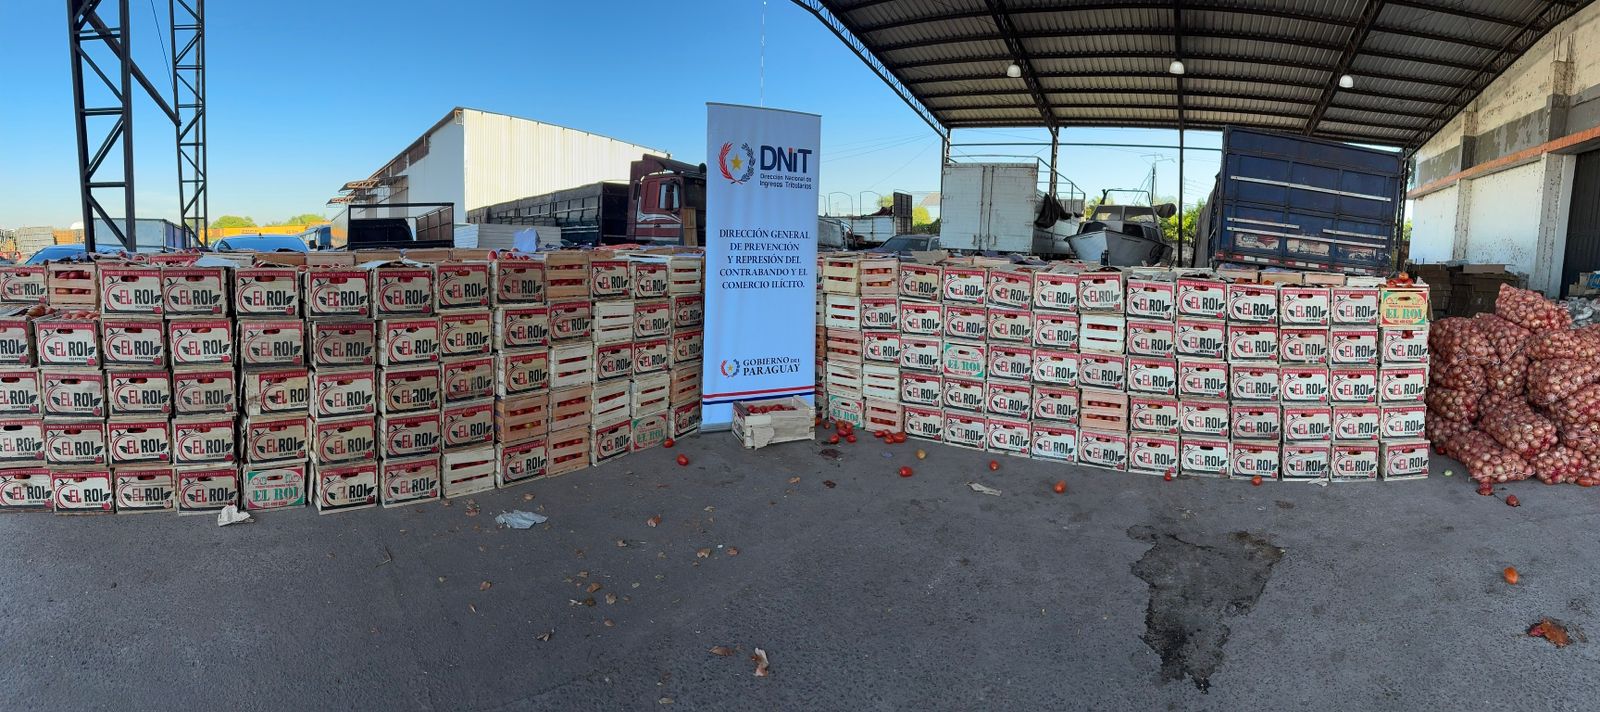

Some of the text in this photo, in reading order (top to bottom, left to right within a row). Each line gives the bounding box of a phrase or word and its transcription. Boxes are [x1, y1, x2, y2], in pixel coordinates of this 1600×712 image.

[719, 228, 810, 239] DIRECCIÓN GENERAL
[730, 241, 799, 251] DE PREVENCIÓN
[727, 254, 801, 264] Y REPRESIÓN DEL
[13, 282, 40, 295] EL ROI
[453, 281, 482, 297] EL ROI
[722, 279, 805, 289] COMERCIO ILÍCITO.
[910, 280, 932, 292] EL ROI
[120, 289, 155, 305] EL ROI
[180, 289, 212, 305] EL ROI
[254, 289, 285, 305] EL ROI
[394, 288, 424, 305] EL ROI
[1056, 290, 1070, 303] ROI
[1090, 290, 1114, 302] EL ROI
[1190, 296, 1218, 309] EL ROI
[1140, 298, 1164, 311] EL ROI
[1243, 302, 1269, 316] EL ROI
[1345, 304, 1369, 317] EL ROI
[912, 318, 934, 328] EL ROI
[1000, 324, 1024, 335] EL ROI
[517, 325, 542, 339] EL ROI
[1048, 329, 1072, 341] EL ROI
[455, 332, 482, 346] EL ROI
[1141, 338, 1166, 351] EL ROI
[55, 341, 88, 356] EL ROI
[120, 340, 154, 356] EL ROI
[189, 340, 222, 355] EL ROI
[261, 342, 293, 356] EL ROI
[333, 341, 364, 356] EL ROI
[402, 340, 432, 355] EL ROI
[1244, 340, 1270, 353] EL ROI
[1345, 345, 1369, 357] EL ROI
[644, 354, 663, 365] EL ROI
[743, 356, 789, 365] GOBIERNO
[743, 364, 800, 376] PARAGUAY
[1001, 361, 1024, 372] EL ROI
[1055, 365, 1069, 378] ROI
[517, 368, 542, 383] EL ROI
[1142, 375, 1167, 388] EL ROI
[1192, 377, 1219, 390] EL ROI
[1294, 383, 1320, 396] EL ROI
[1393, 383, 1418, 395] EL ROI
[61, 392, 93, 406] EL ROI
[129, 390, 161, 405] EL ROI
[193, 390, 224, 405] EL ROI
[335, 392, 363, 406] EL ROI
[999, 398, 1022, 410] EL ROI
[1046, 402, 1070, 414] EL ROI
[1196, 416, 1220, 428] EL ROI
[1348, 422, 1372, 435] EL ROI
[459, 422, 486, 437] EL ROI
[1299, 423, 1324, 435] EL ROI
[4, 437, 34, 451] EL ROI
[128, 439, 159, 454] EL ROI
[193, 439, 225, 454] EL ROI
[266, 437, 296, 452] EL ROI
[402, 433, 432, 449] EL ROI
[999, 434, 1022, 446] EL ROI
[61, 441, 93, 456] EL ROI
[1093, 448, 1118, 462] EL ROI
[1142, 452, 1169, 465] EL ROI
[1245, 459, 1271, 472] EL ROI
[1345, 460, 1369, 472] EL ROI
[401, 479, 429, 493] EL ROI
[13, 486, 44, 500] EL ROI
[69, 489, 103, 503] EL ROI
[132, 487, 163, 502] EL ROI
[196, 487, 228, 503] EL ROI
